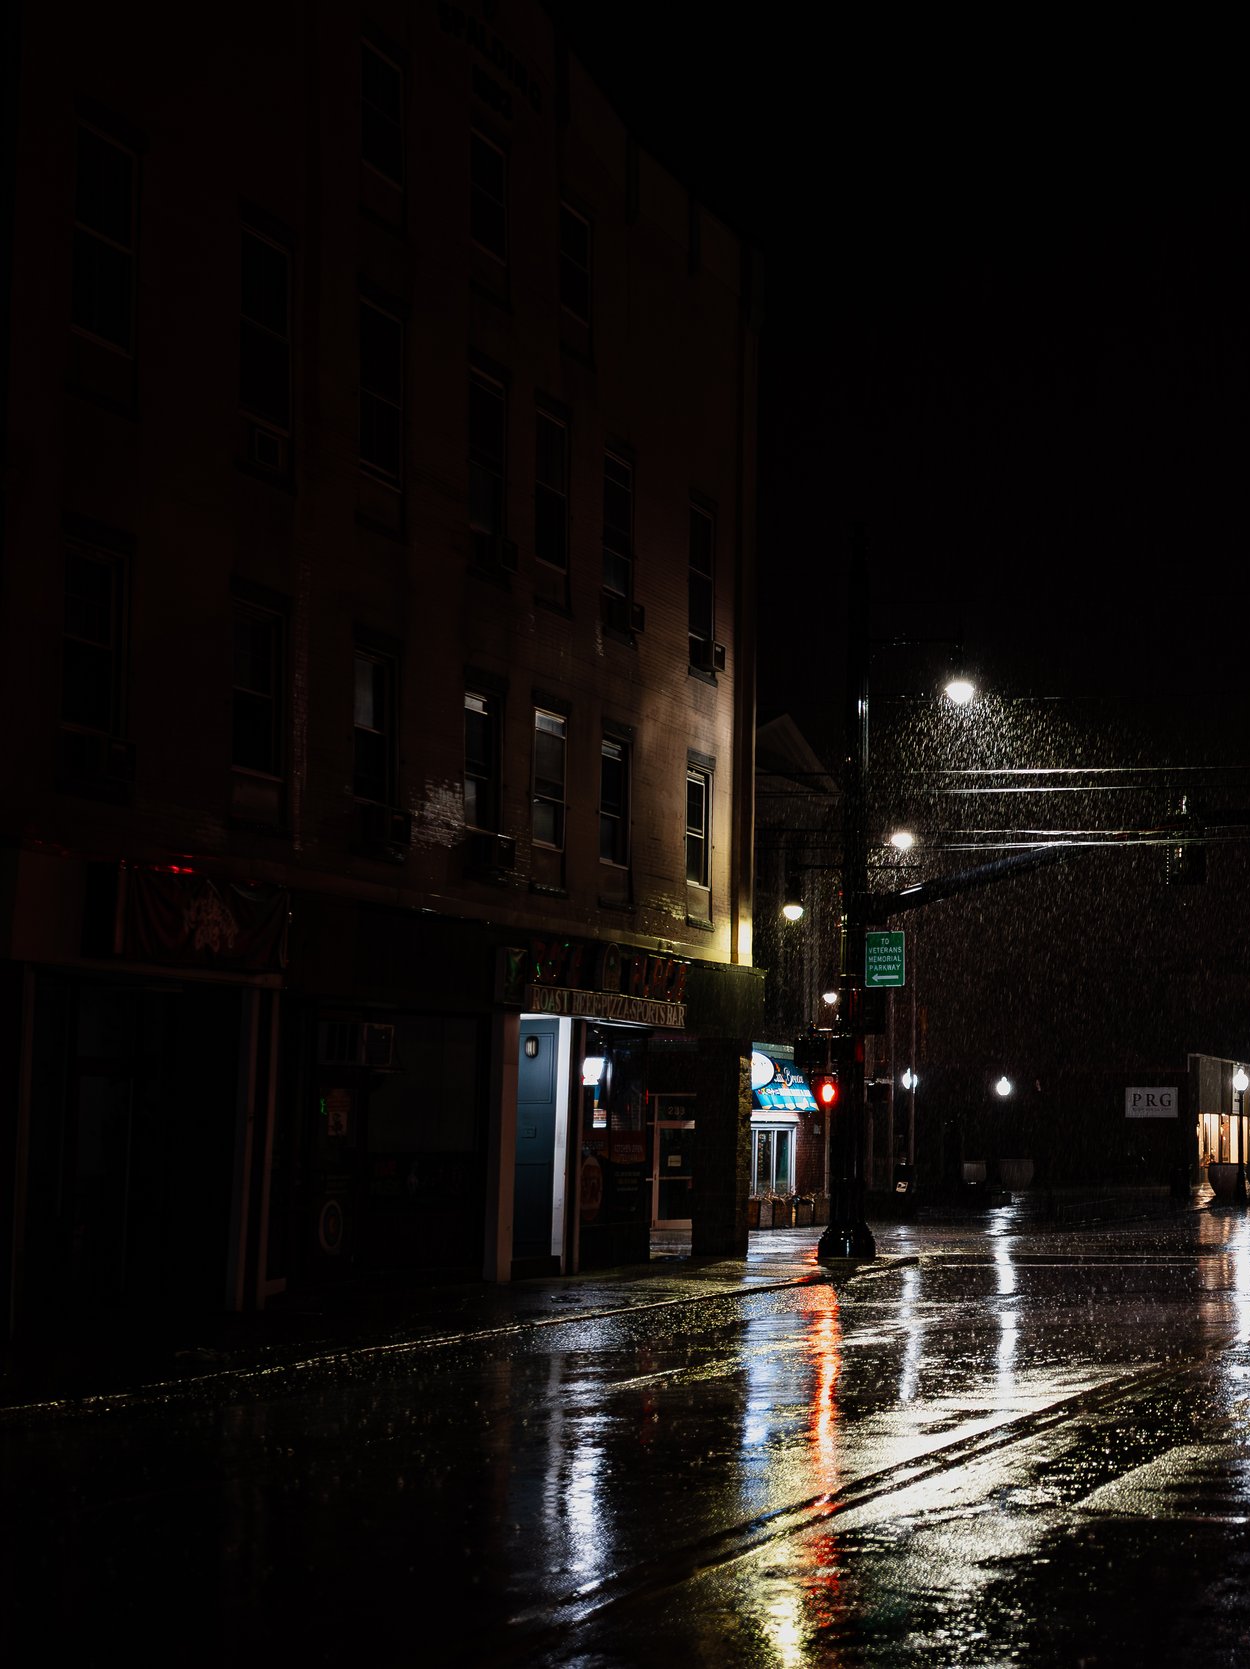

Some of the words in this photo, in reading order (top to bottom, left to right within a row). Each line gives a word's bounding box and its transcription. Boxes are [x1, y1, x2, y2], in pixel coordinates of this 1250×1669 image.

[533, 988, 570, 1012] ROAST
[572, 991, 600, 1016] BEEF
[601, 995, 630, 1019] PIZZA
[631, 999, 666, 1025] SPORTS
[667, 1004, 686, 1027] BAR
[1132, 1093, 1171, 1106] PRG
